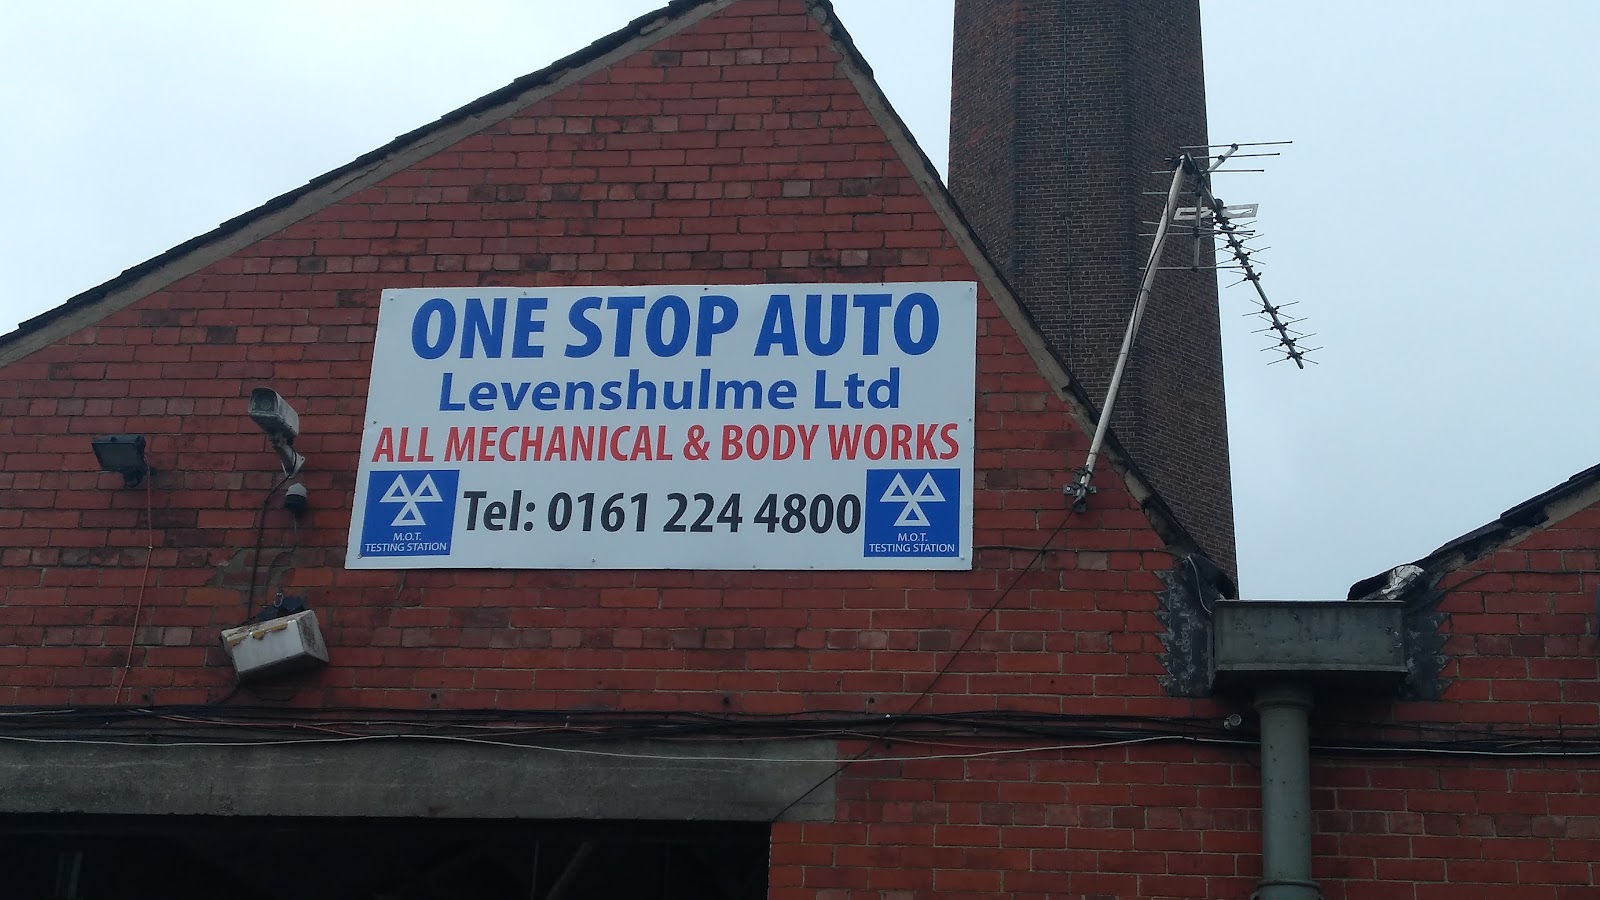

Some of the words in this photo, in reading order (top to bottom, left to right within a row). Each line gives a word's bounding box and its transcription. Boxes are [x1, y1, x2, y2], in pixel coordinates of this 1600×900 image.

[412, 294, 548, 359] ONE
[564, 295, 738, 358] STOP
[754, 293, 939, 356] AUTO
[440, 369, 797, 411] Levenshulme
[815, 367, 899, 409] Ltd
[372, 427, 433, 462] ALL
[444, 426, 672, 461] MECHANICAL
[683, 425, 710, 460] &
[721, 425, 819, 460] BODY
[828, 424, 958, 460] WORKS
[464, 490, 535, 531] Tel:
[548, 492, 647, 532] 0161
[663, 493, 743, 532] 224
[754, 494, 861, 534] 4800
[364, 542, 405, 552] TESTING
[406, 542, 447, 552] STATION
[392, 531, 422, 542] M.O.T.
[868, 543, 911, 553] TESTING
[912, 543, 955, 553] STATION
[897, 532, 928, 542] M.O.T.
